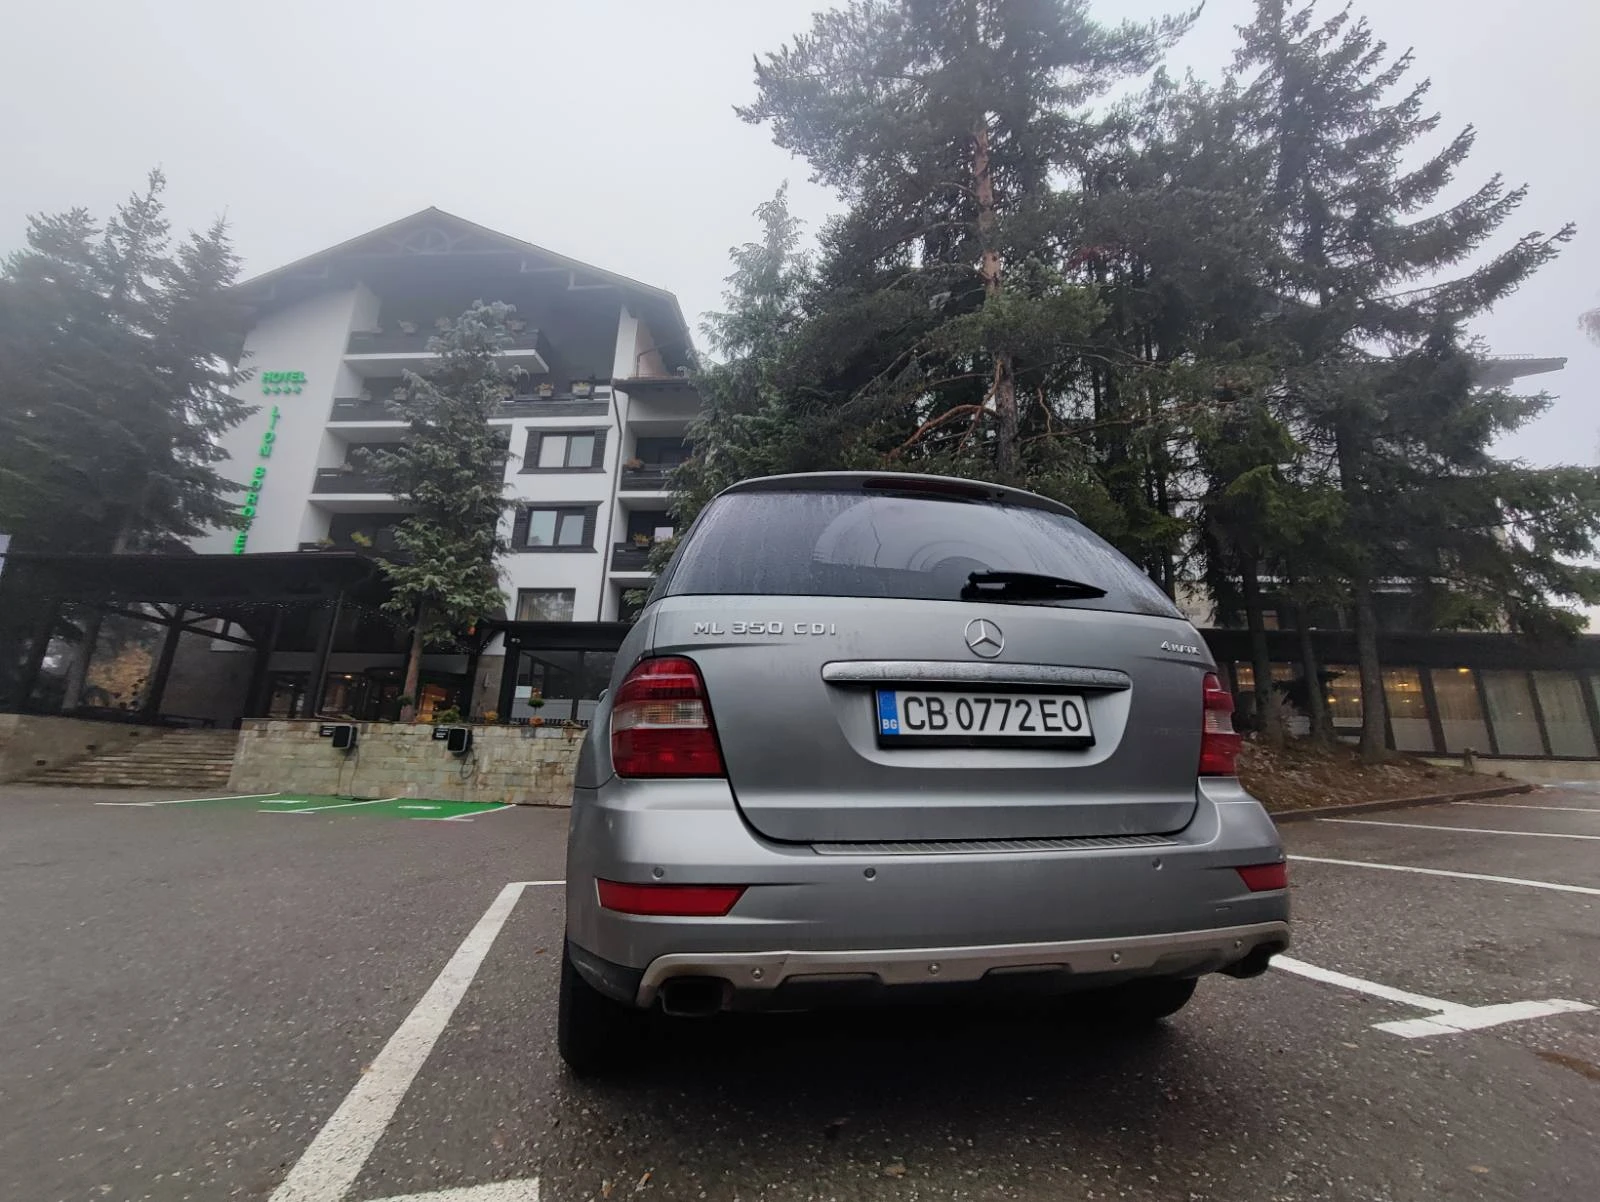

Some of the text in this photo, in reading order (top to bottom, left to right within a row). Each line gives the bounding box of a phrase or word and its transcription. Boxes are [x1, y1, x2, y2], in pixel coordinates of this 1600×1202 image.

[262, 371, 305, 383] HOTEL
[260, 405, 280, 459] LION
[693, 621, 836, 636] ML 350 CDI
[882, 719, 898, 730] BG
